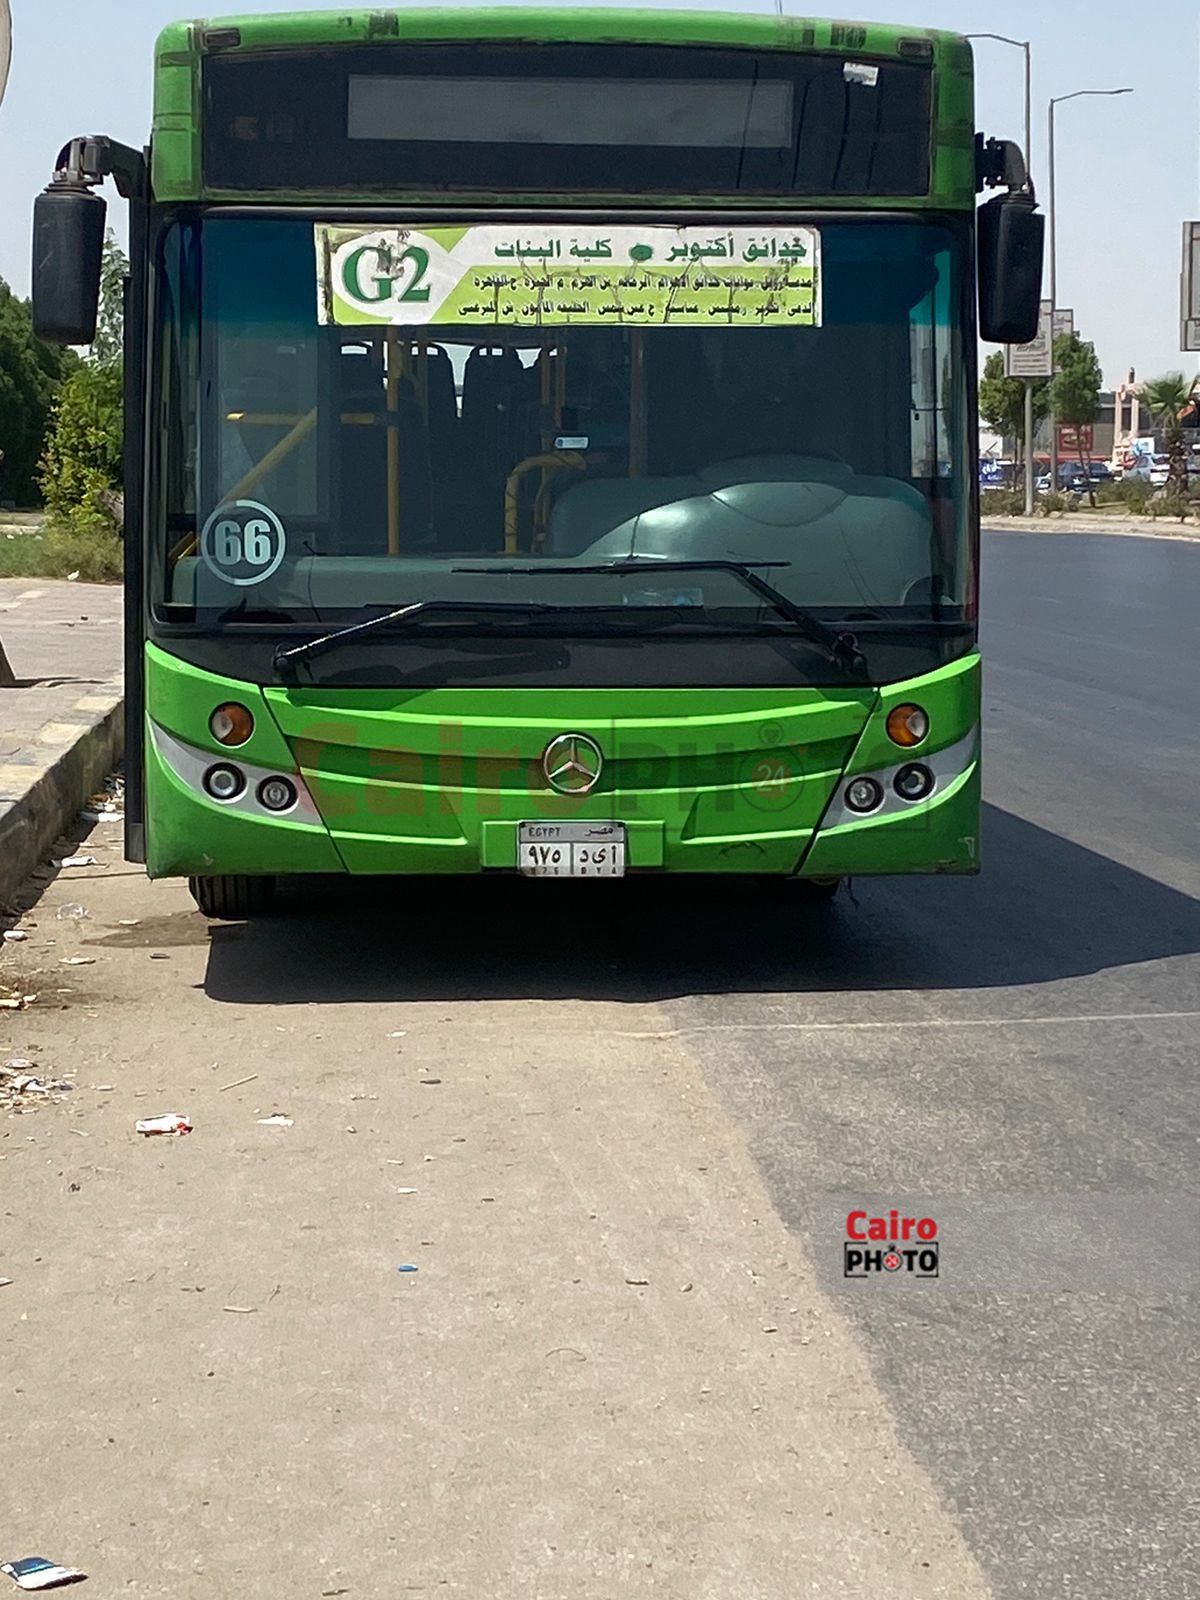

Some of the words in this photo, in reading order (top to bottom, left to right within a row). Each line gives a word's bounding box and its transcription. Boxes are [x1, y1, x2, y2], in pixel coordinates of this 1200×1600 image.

[494, 239, 562, 263] البنات
[569, 238, 613, 263] كلية
[665, 232, 735, 262] أكتوبر
[743, 237, 808, 263] حدائق
[342, 244, 432, 304] G2
[214, 519, 272, 565] 66
[528, 826, 562, 837] EGYPT
[583, 826, 614, 837] مصر
[528, 845, 561, 865] ٩٧٥
